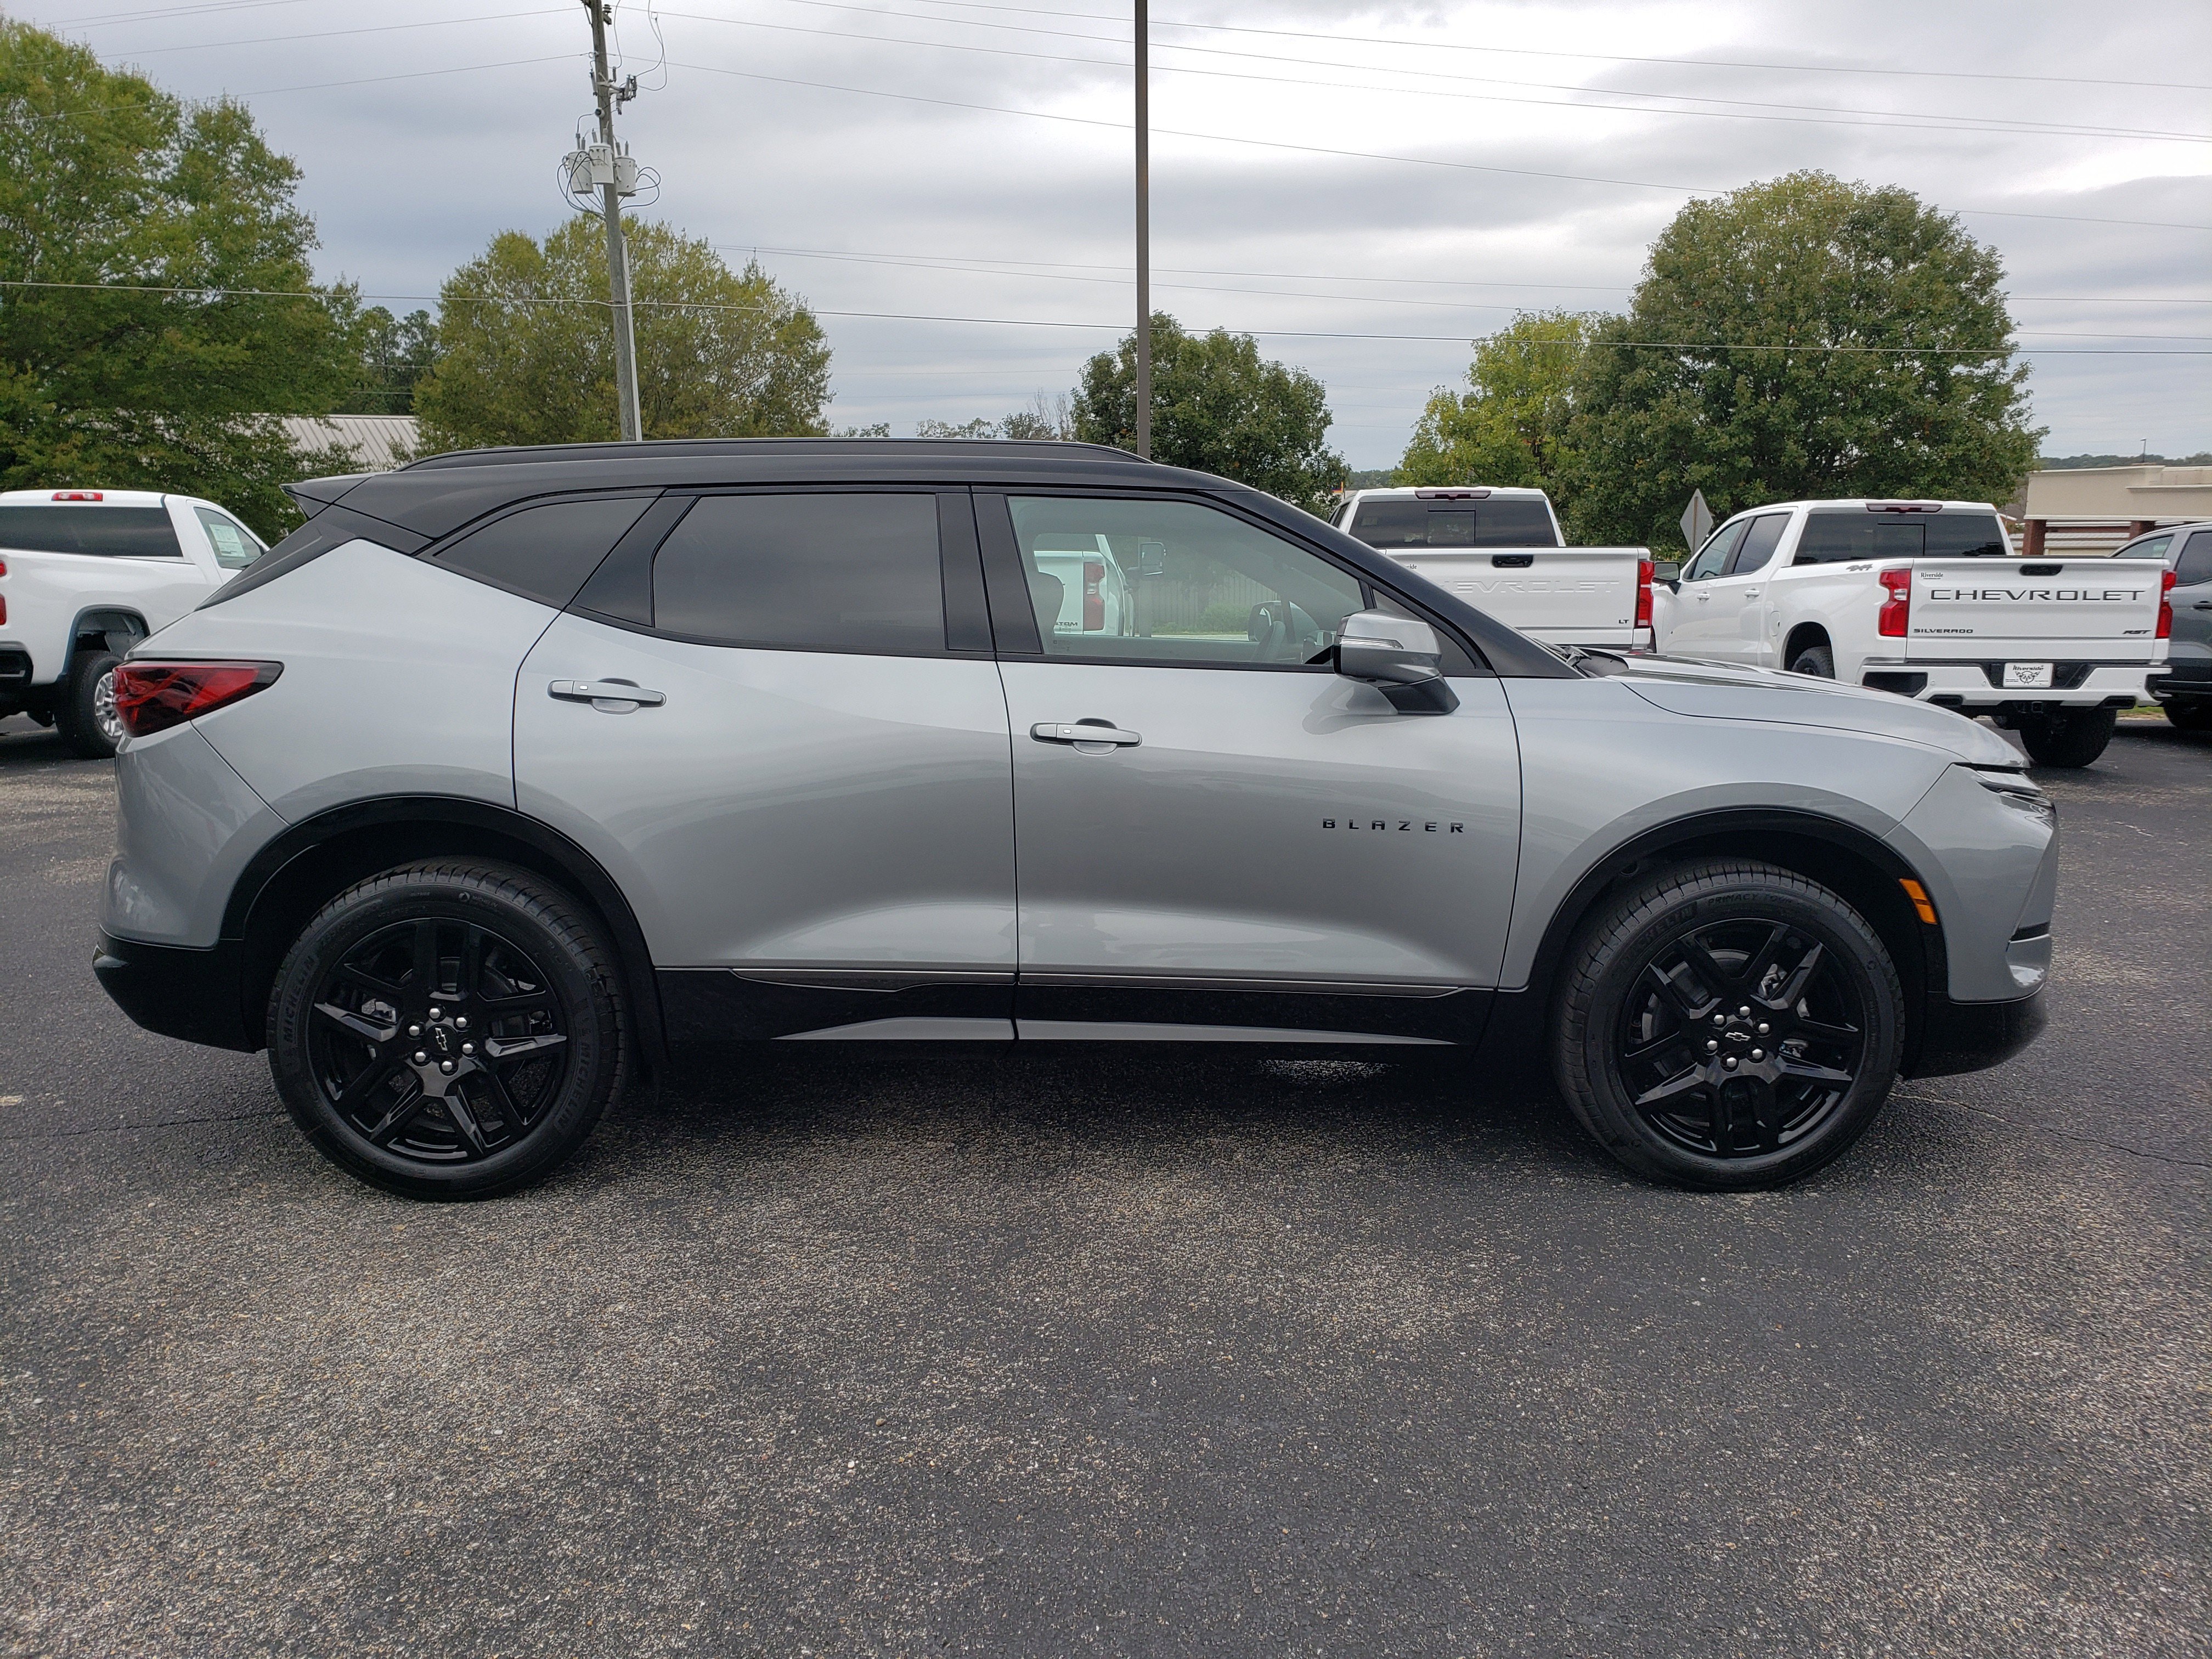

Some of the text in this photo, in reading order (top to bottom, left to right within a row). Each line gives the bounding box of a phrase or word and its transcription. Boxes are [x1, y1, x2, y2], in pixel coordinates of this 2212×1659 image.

[1441, 581, 1619, 593] EVROLET
[1931, 590, 2146, 601] CHEVROLET
[1323, 818, 1464, 833] BLAZER
[1707, 893, 1757, 907] PRIMACY
[283, 955, 316, 1045] MICHELIN
[557, 1041, 591, 1129] MICHELIN
